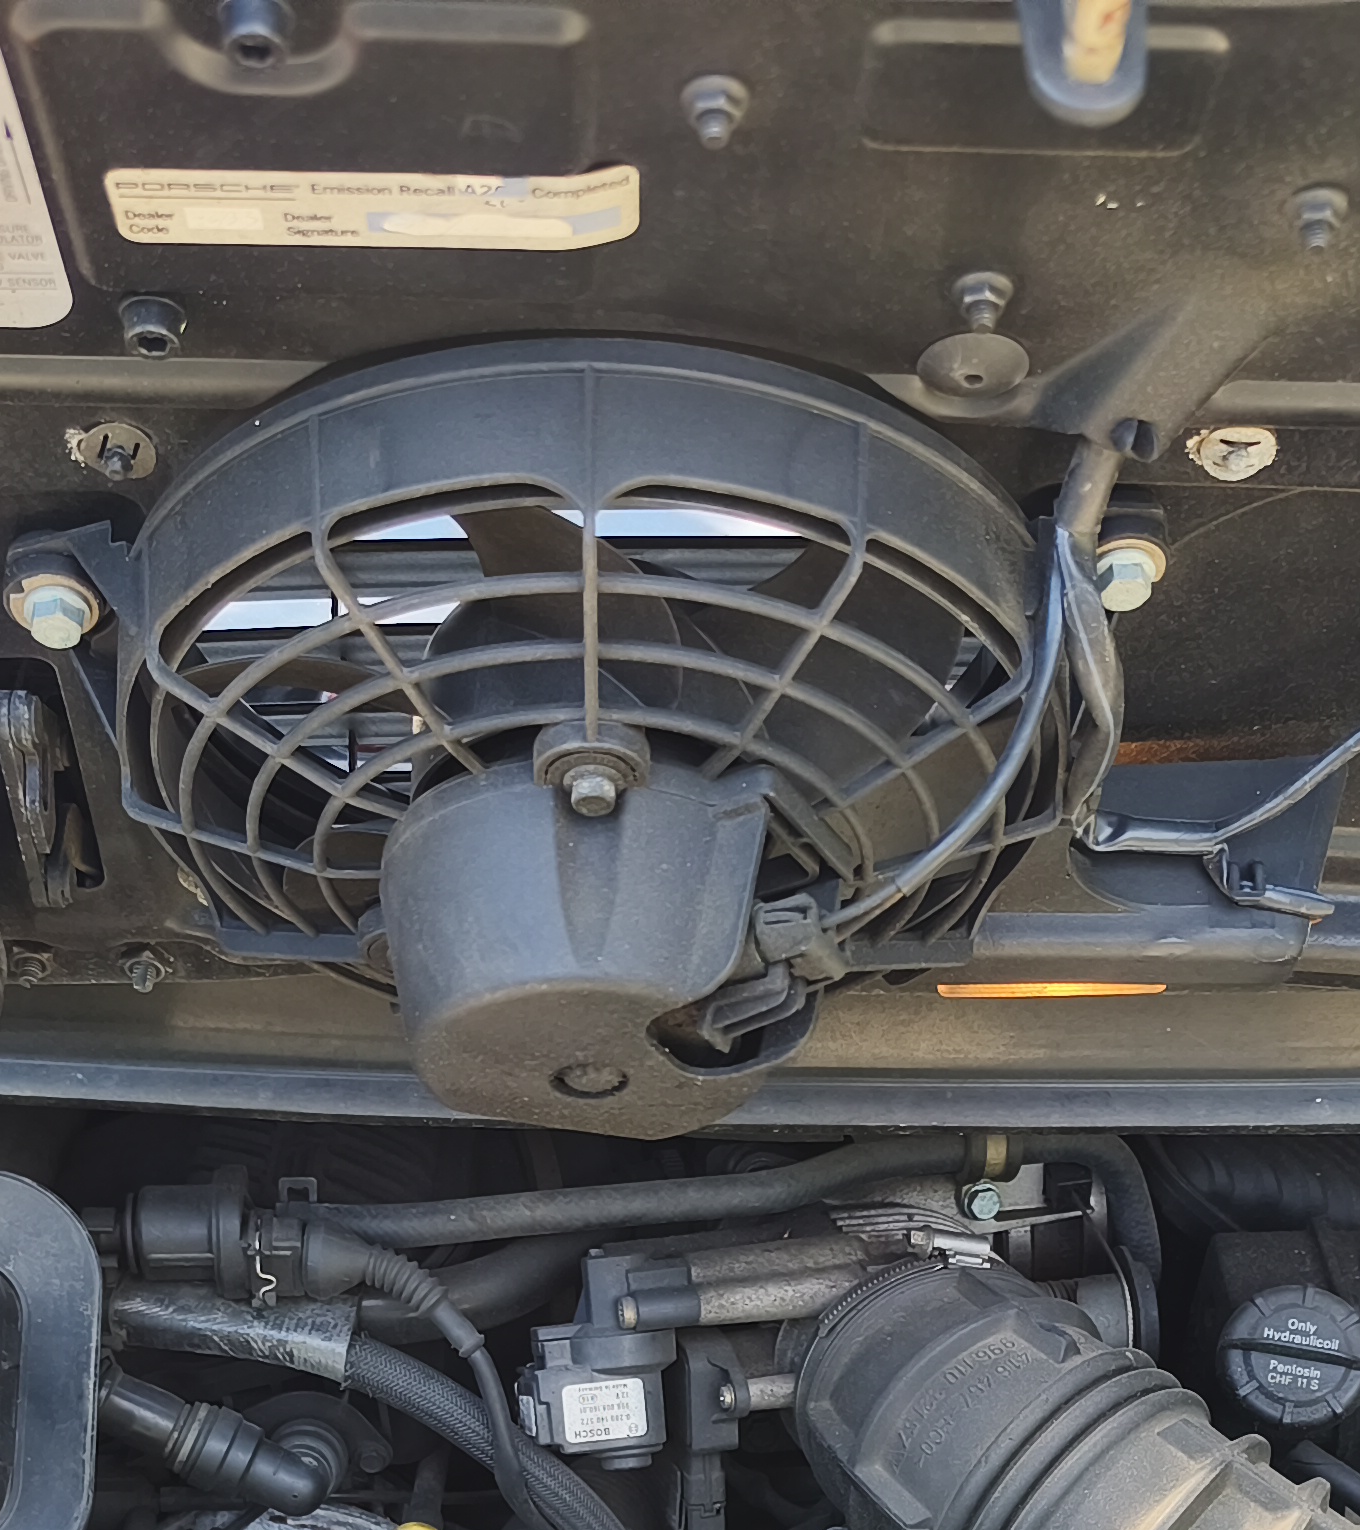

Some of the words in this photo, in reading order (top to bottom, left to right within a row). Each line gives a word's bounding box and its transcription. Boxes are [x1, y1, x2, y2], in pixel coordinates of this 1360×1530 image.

[115, 181, 296, 194] PORSCHE
[311, 184, 392, 197] Emission
[399, 184, 455, 198] Recall
[531, 175, 630, 200] Completed
[124, 210, 175, 222] Dealer
[283, 212, 332, 223] Dealer
[128, 223, 169, 235] Code
[286, 226, 359, 239] Signature
[1288, 1318, 1319, 1335] Only
[1263, 1326, 1340, 1351] Hydraulicoil
[1267, 1372, 1293, 1386] CHF
[574, 1426, 611, 1440] BOSCH
